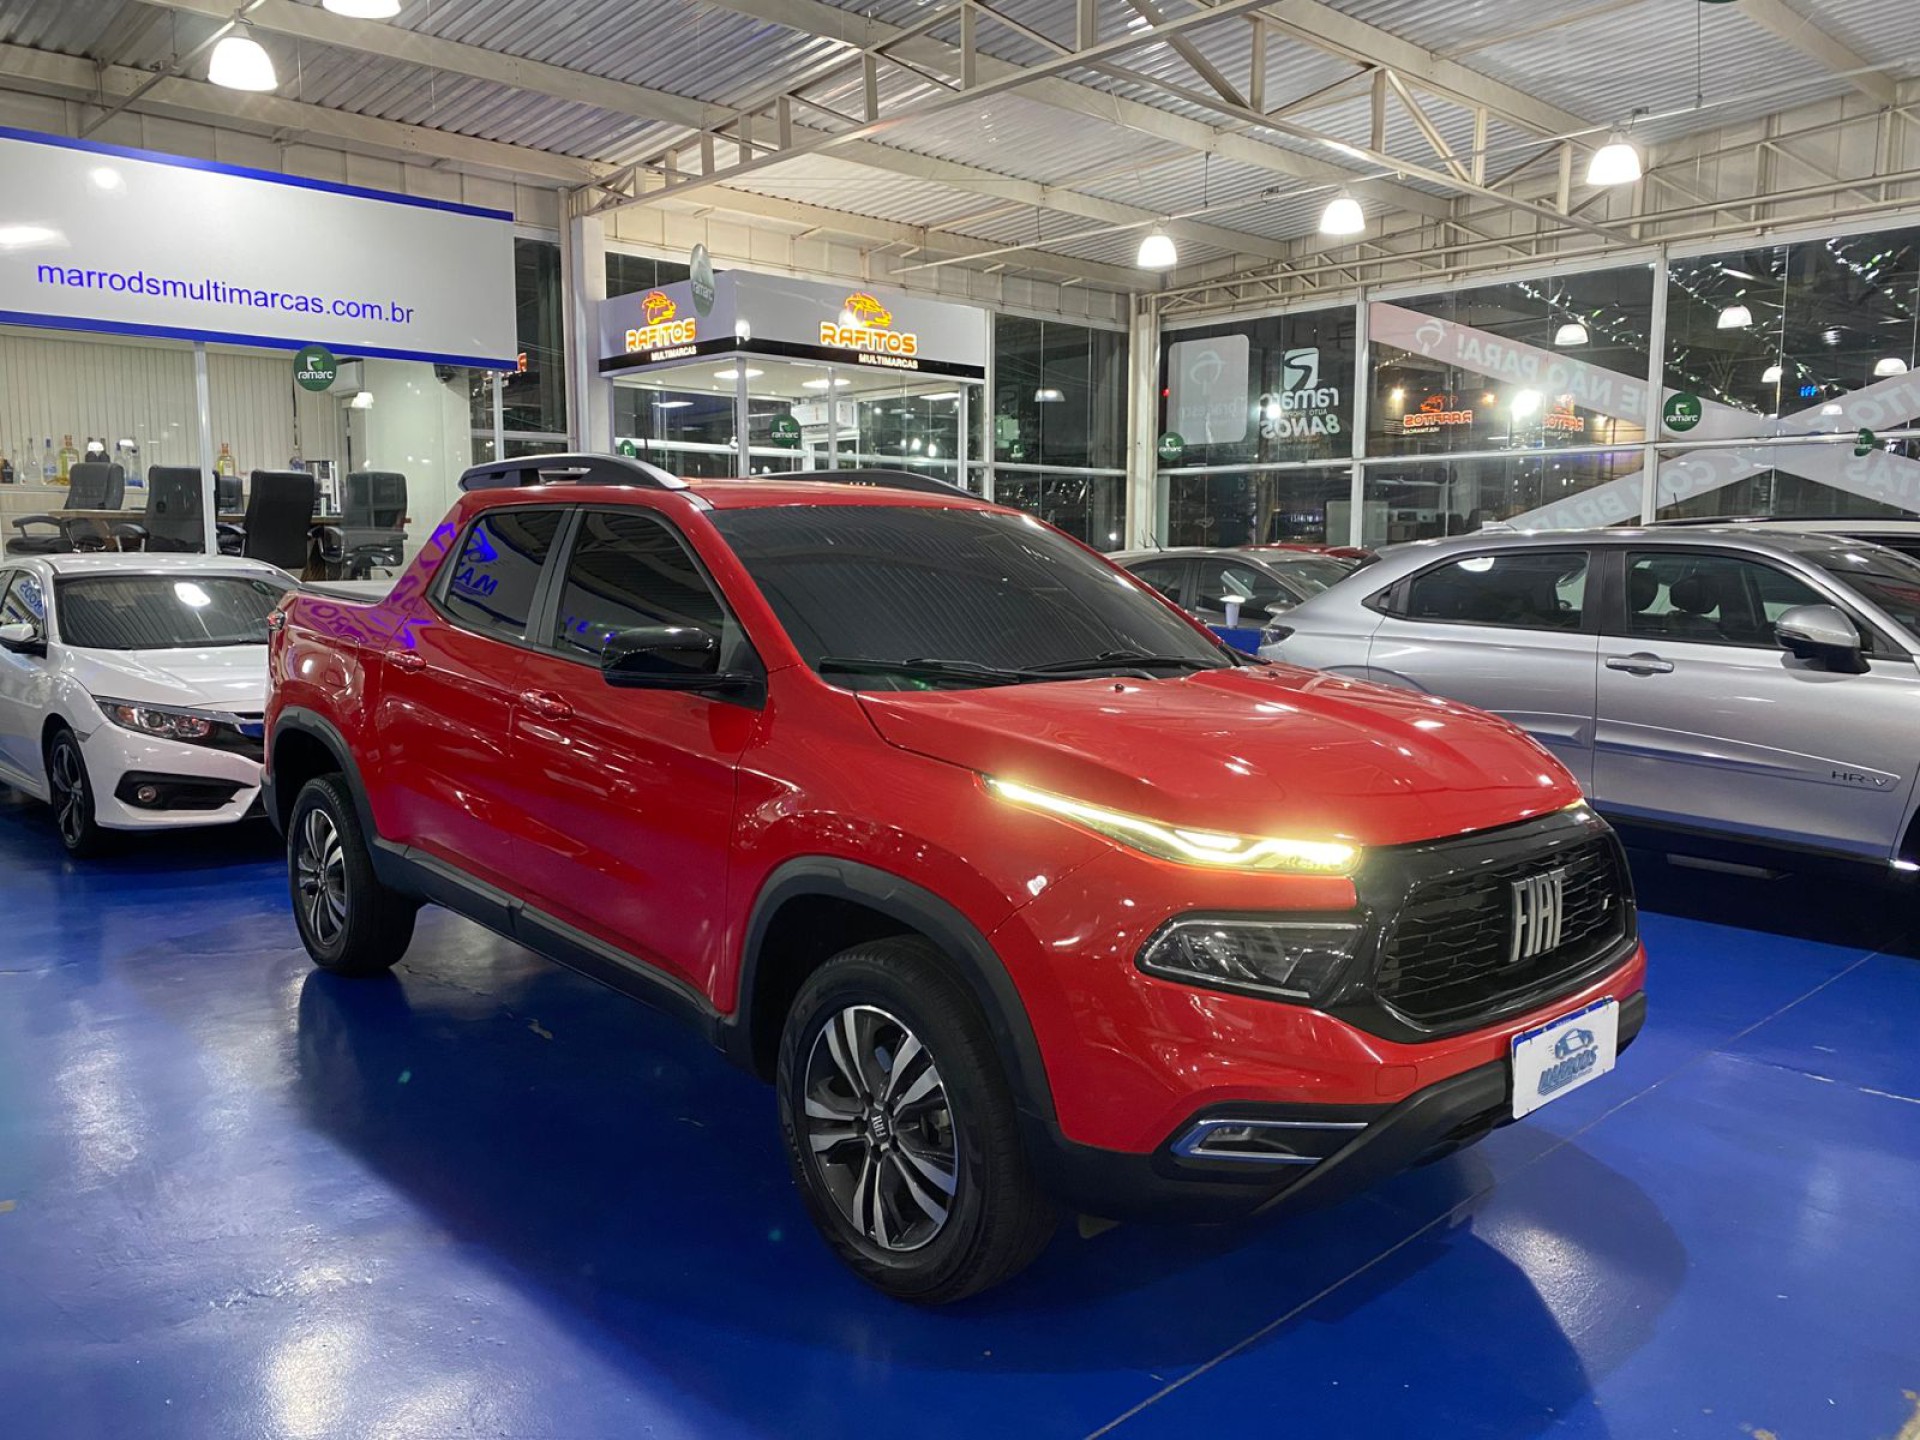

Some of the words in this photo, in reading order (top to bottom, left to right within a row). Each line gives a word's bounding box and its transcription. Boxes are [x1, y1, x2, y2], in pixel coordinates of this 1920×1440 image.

[37, 263, 414, 324] marrodsmultimarcas.com.br
[625, 317, 696, 352] RAFITOS
[820, 321, 917, 356] RAFITOS
[651, 345, 697, 361] MULTIMARCAS
[858, 353, 919, 370] MULTIMARCAS
[297, 369, 333, 381] ramarc
[1665, 412, 1698, 423] ramarc
[771, 431, 799, 439] ramarc
[1832, 771, 1889, 787] HR-V
[1509, 867, 1567, 963] FIAT
